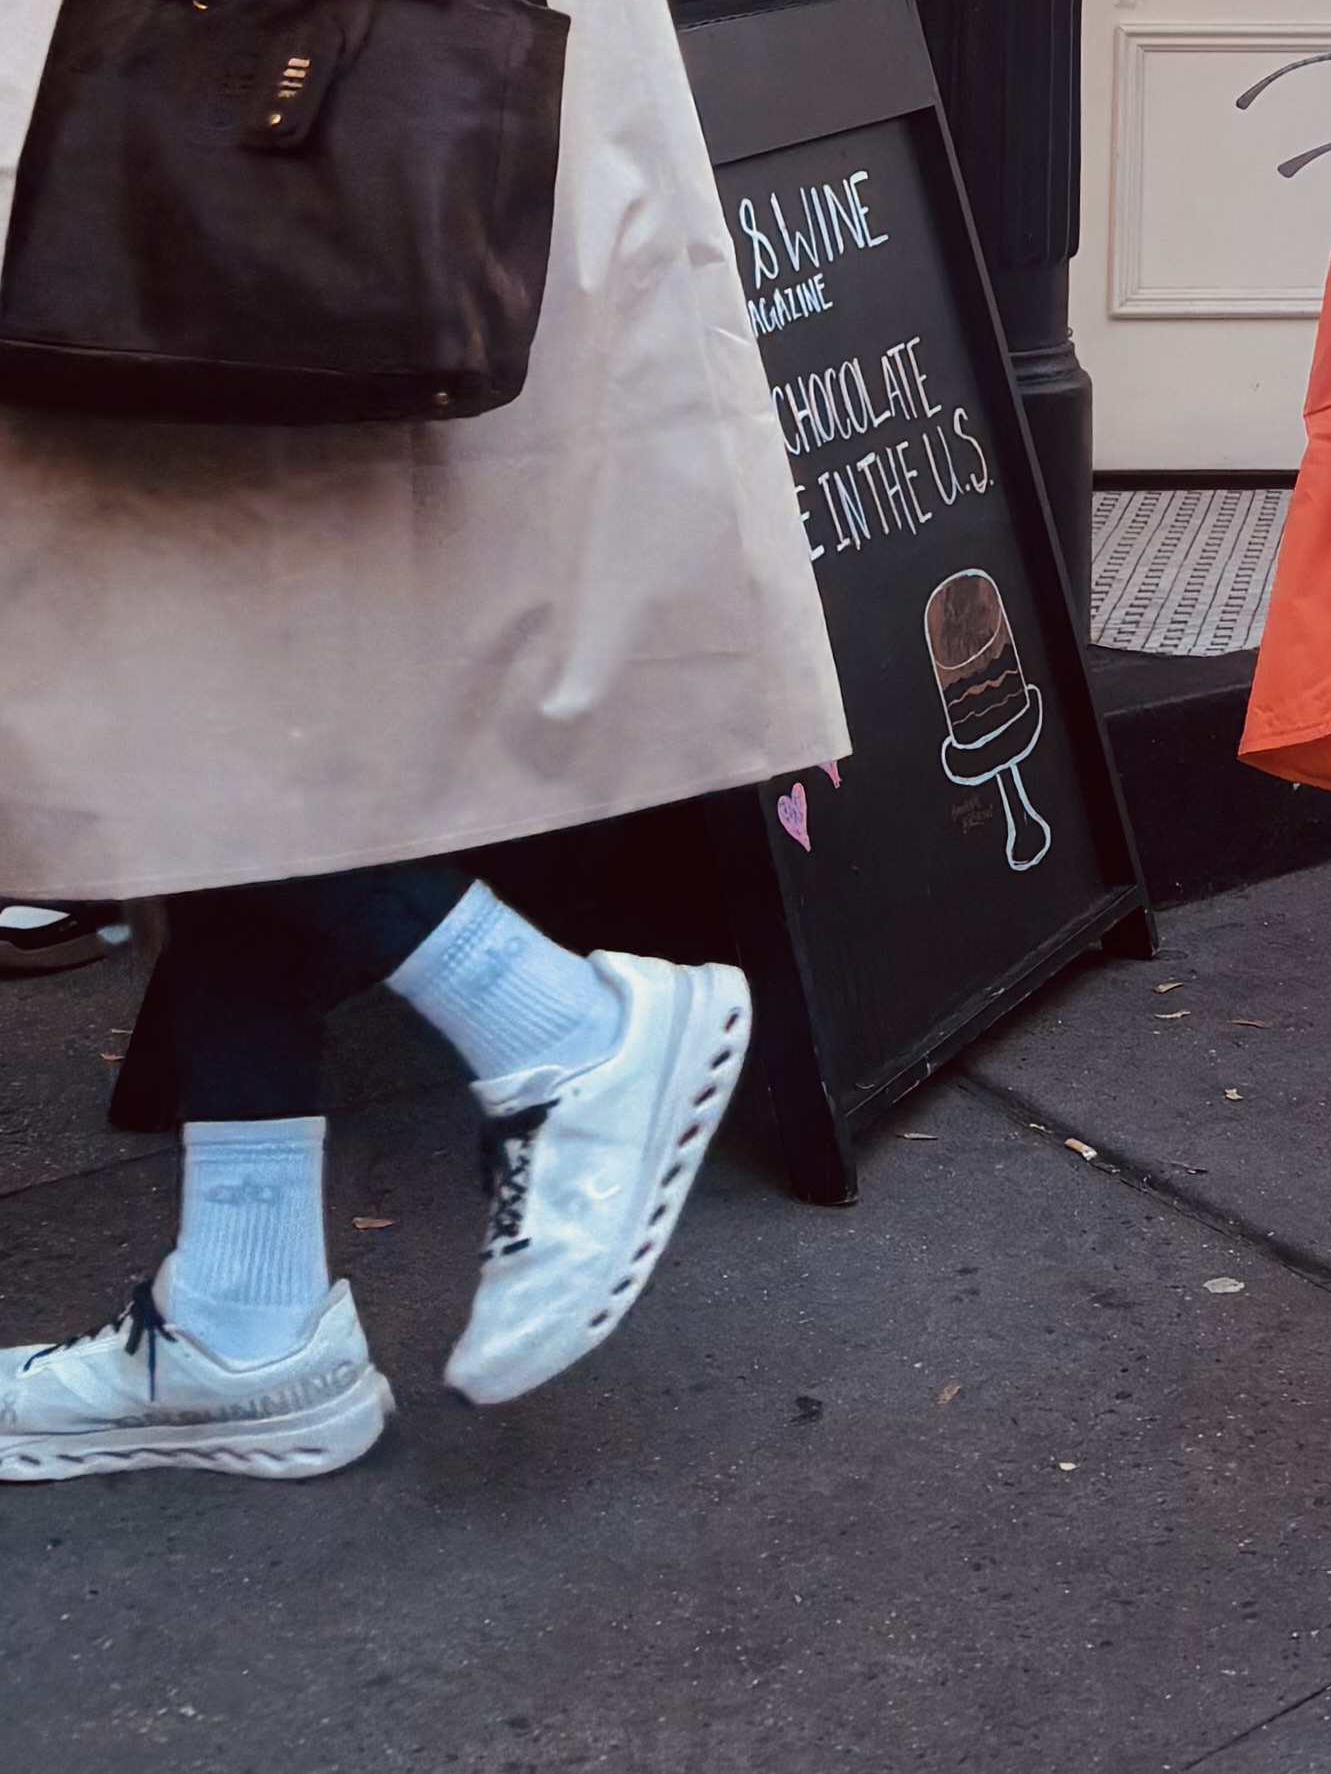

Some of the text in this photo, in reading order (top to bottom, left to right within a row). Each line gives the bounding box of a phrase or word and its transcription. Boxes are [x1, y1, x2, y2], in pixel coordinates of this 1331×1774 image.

[770, 170, 889, 272] WINE
[772, 336, 942, 456] CHOCOLATE
[818, 464, 872, 551] IN
[856, 440, 933, 536] THE
